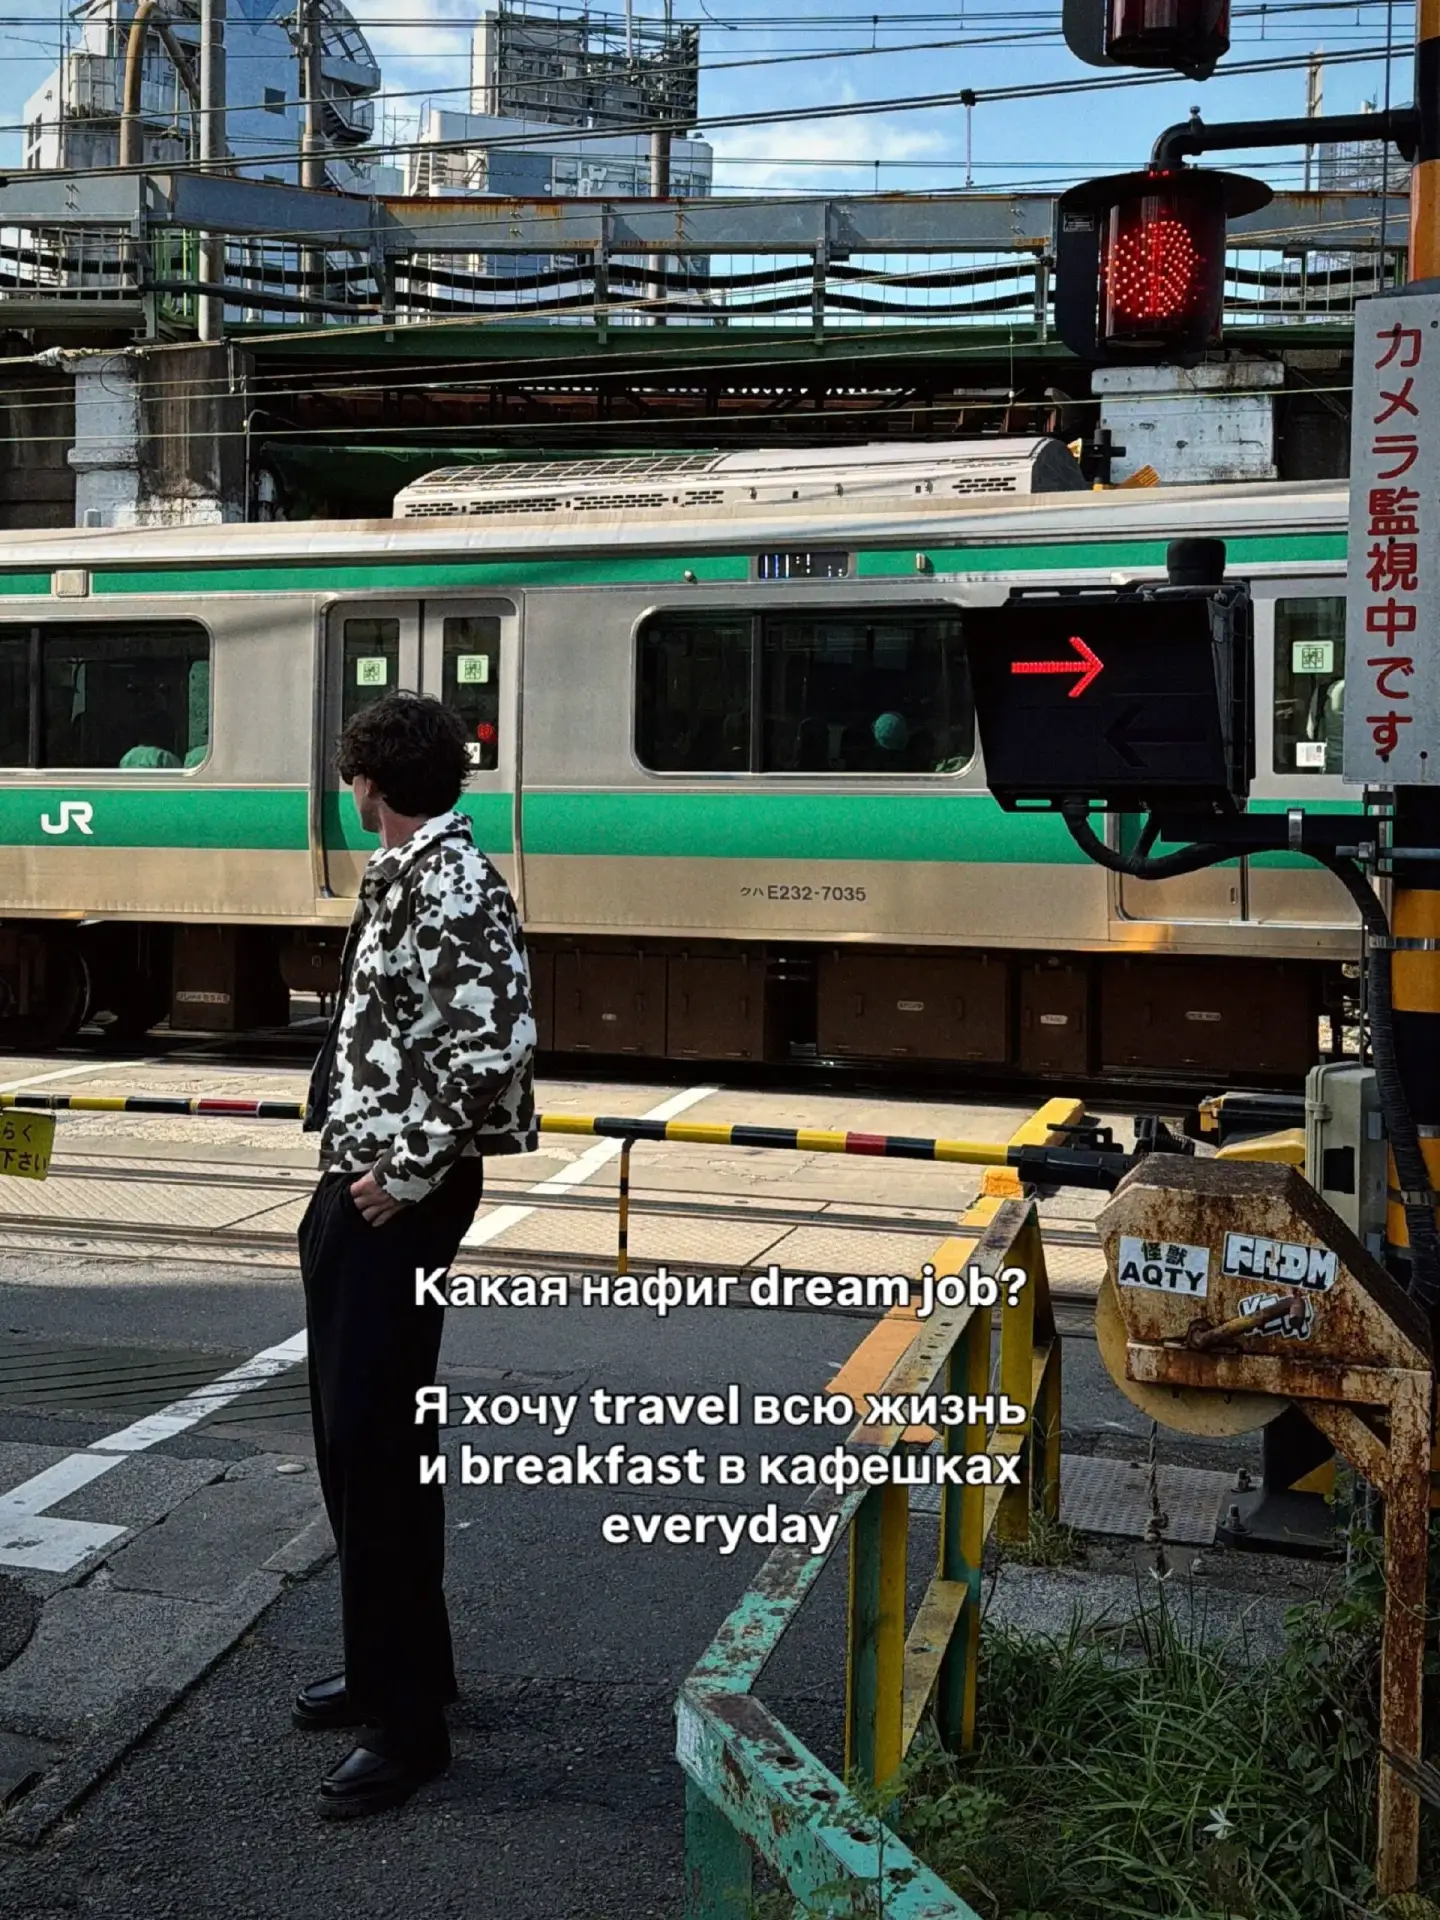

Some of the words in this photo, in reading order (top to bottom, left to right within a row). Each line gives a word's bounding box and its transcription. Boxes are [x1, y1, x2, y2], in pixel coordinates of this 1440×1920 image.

[1366, 323, 1422, 758] カメラ監視中です
[41, 801, 94, 834] JR
[3, 1121, 32, 1142] らく
[0, 1148, 47, 1172] 下さい
[1120, 1261, 1205, 1291] AQTY
